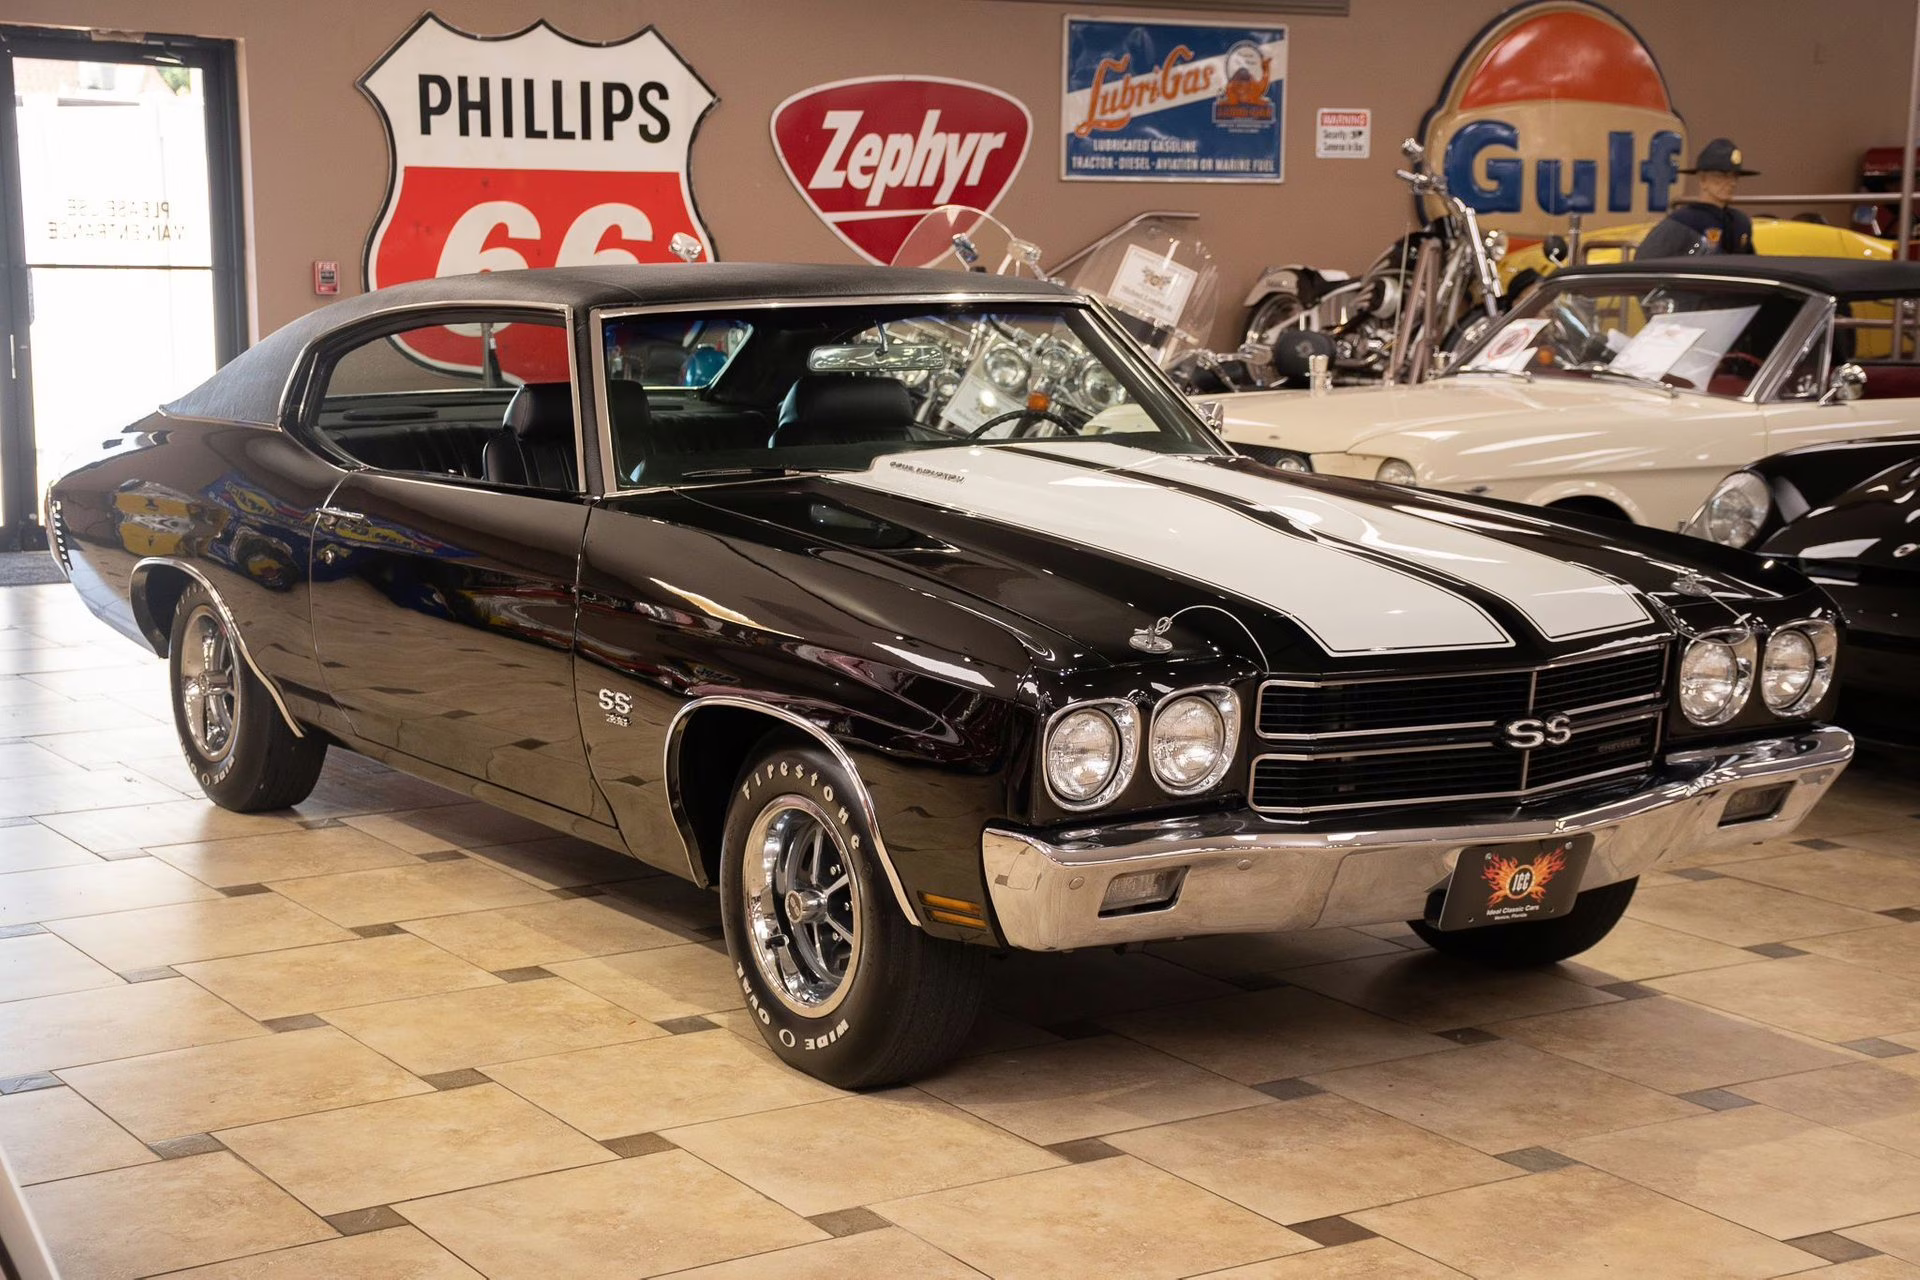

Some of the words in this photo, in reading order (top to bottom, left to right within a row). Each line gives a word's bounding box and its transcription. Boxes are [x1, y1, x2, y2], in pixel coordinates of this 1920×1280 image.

[418, 74, 670, 143] PHILLIPS
[1323, 114, 1366, 125] WARNING
[808, 109, 1007, 206] Zephyr
[1093, 139, 1149, 152] LUBRICATED
[1151, 140, 1198, 153] GASOLINE
[1072, 156, 1114, 170] TRACTOR
[1118, 157, 1151, 171] DIESEL
[1155, 158, 1198, 171] AVIATION
[1200, 158, 1214, 171] OR
[1215, 158, 1251, 172] MARINE
[1253, 159, 1275, 172] FUEL
[1444, 119, 1682, 215] Gulf
[599, 688, 632, 714] SS
[1506, 715, 1571, 748] SS
[742, 761, 860, 850] Firestone
[1502, 906, 1524, 914] Classic
[736, 961, 771, 1025] OVAL
[804, 1018, 850, 1050] WIDE
